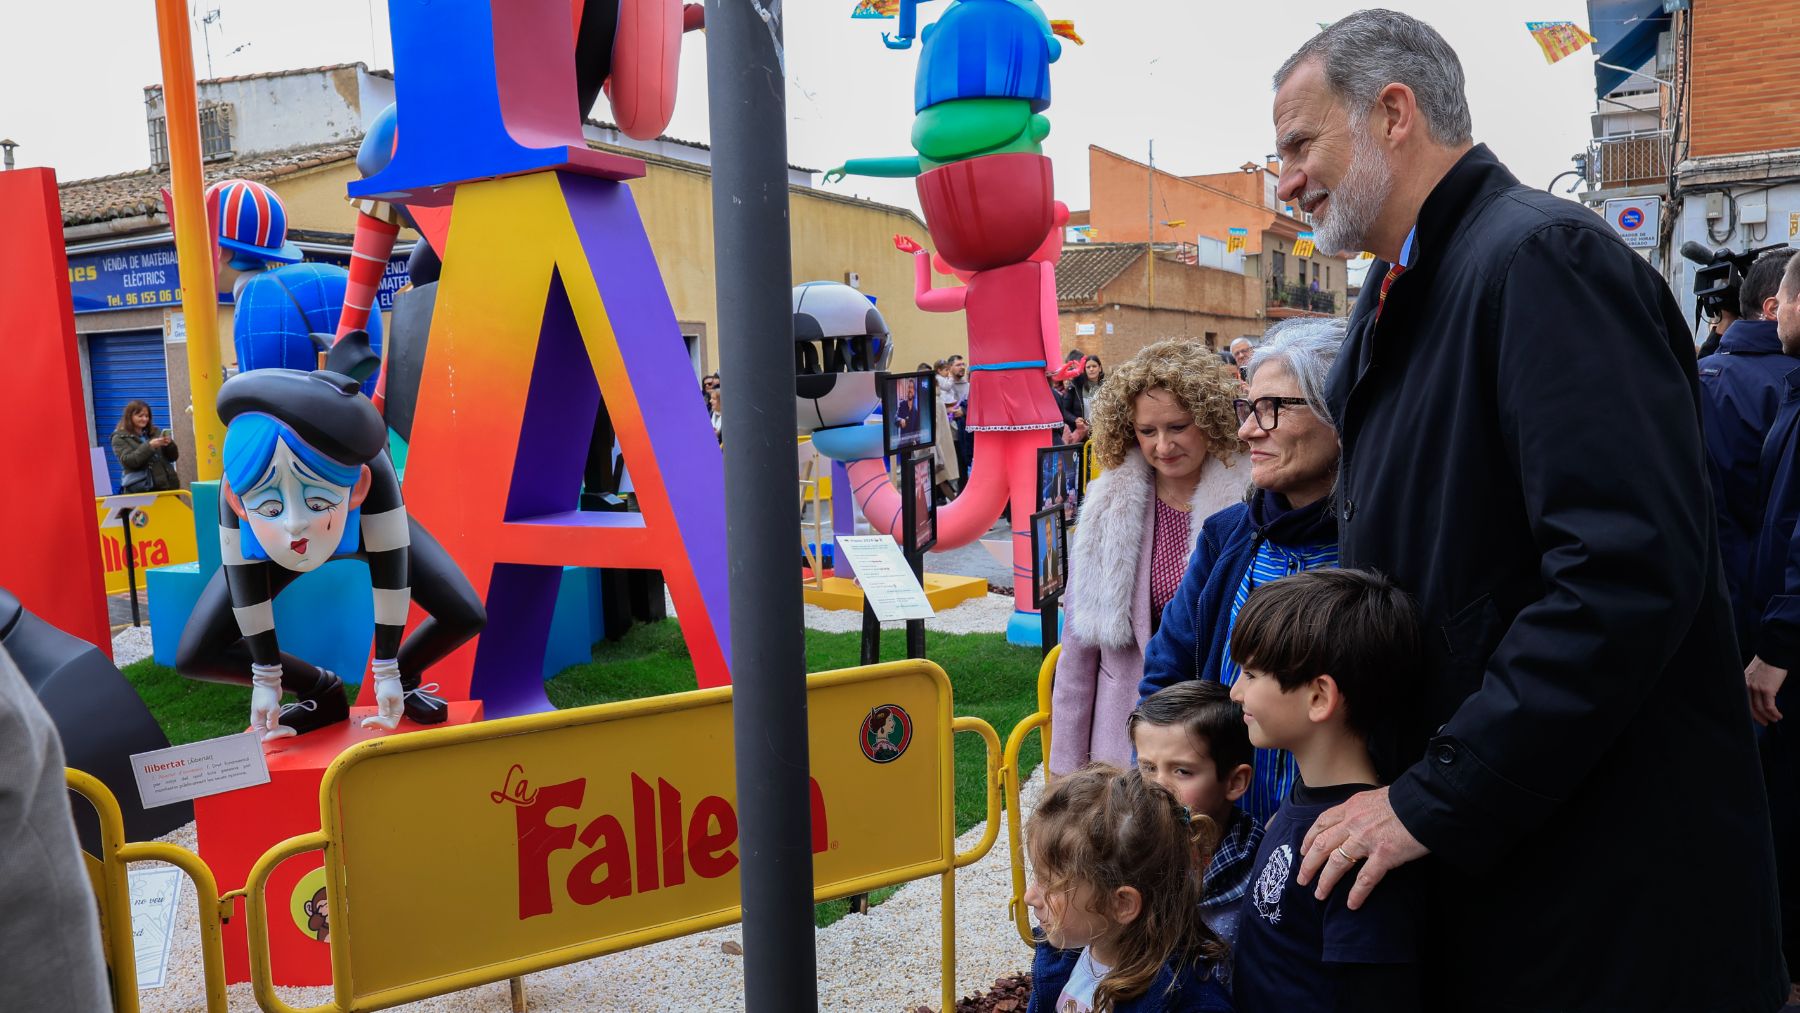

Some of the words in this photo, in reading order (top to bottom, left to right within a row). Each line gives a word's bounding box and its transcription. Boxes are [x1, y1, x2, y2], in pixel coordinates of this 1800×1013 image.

[102, 257, 128, 272] VENDA
[129, 255, 139, 268] DE
[383, 260, 409, 276] ENDA
[123, 270, 166, 288] ELÈCTRICS
[107, 294, 124, 307] Tel.
[126, 293, 138, 305] 96
[141, 291, 156, 304] 155
[159, 289, 172, 302] 06
[102, 533, 170, 573] llera
[144, 759, 186, 774] llibertat
[490, 763, 540, 807] La
